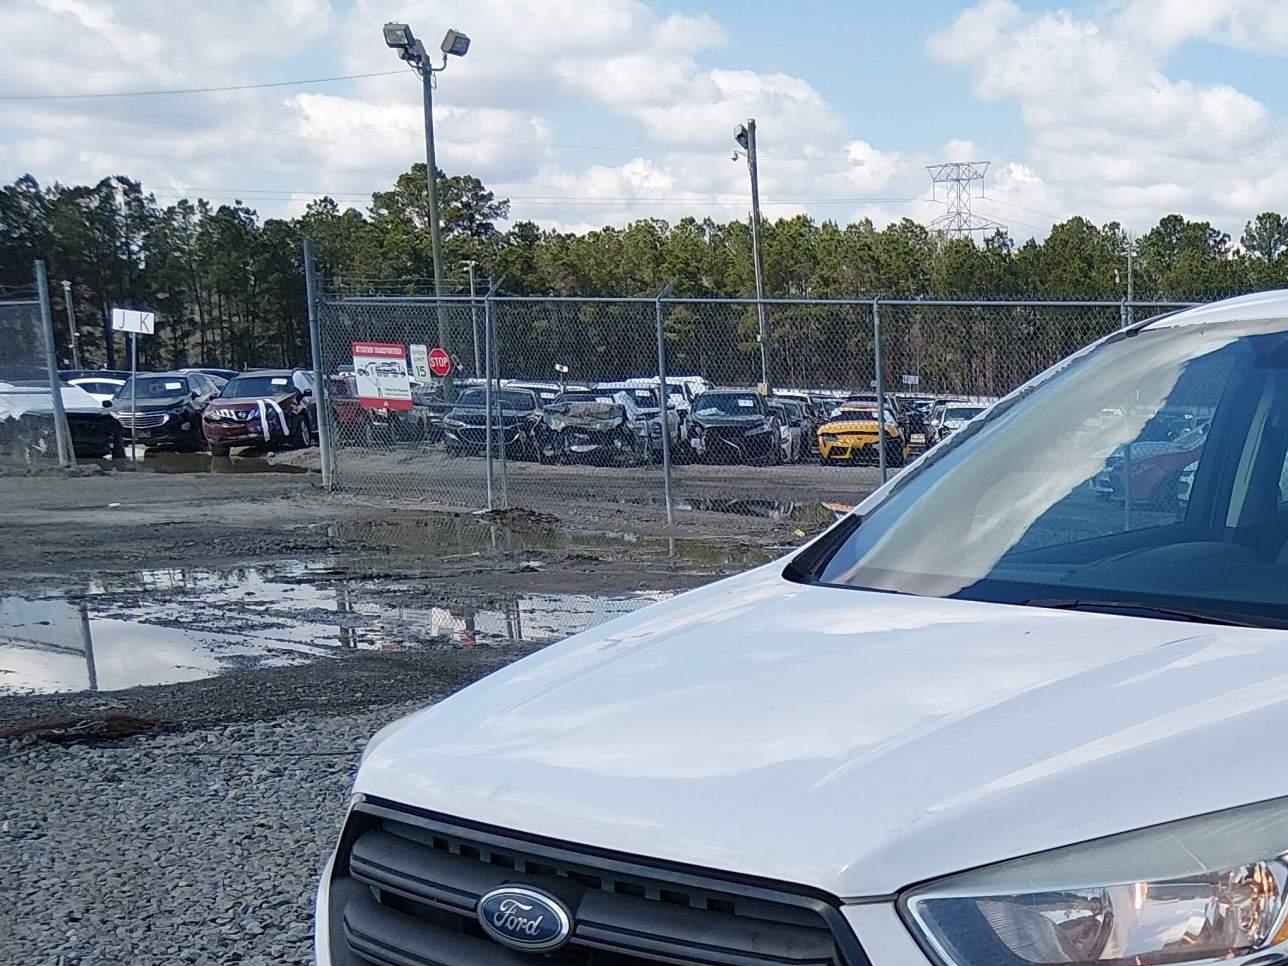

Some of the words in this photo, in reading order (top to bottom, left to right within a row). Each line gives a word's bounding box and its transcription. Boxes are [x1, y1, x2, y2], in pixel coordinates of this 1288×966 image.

[118, 310, 126, 329] J
[140, 312, 150, 332] K
[416, 365, 427, 377] 15
[429, 357, 448, 368] STOP
[493, 899, 544, 936] Ford
